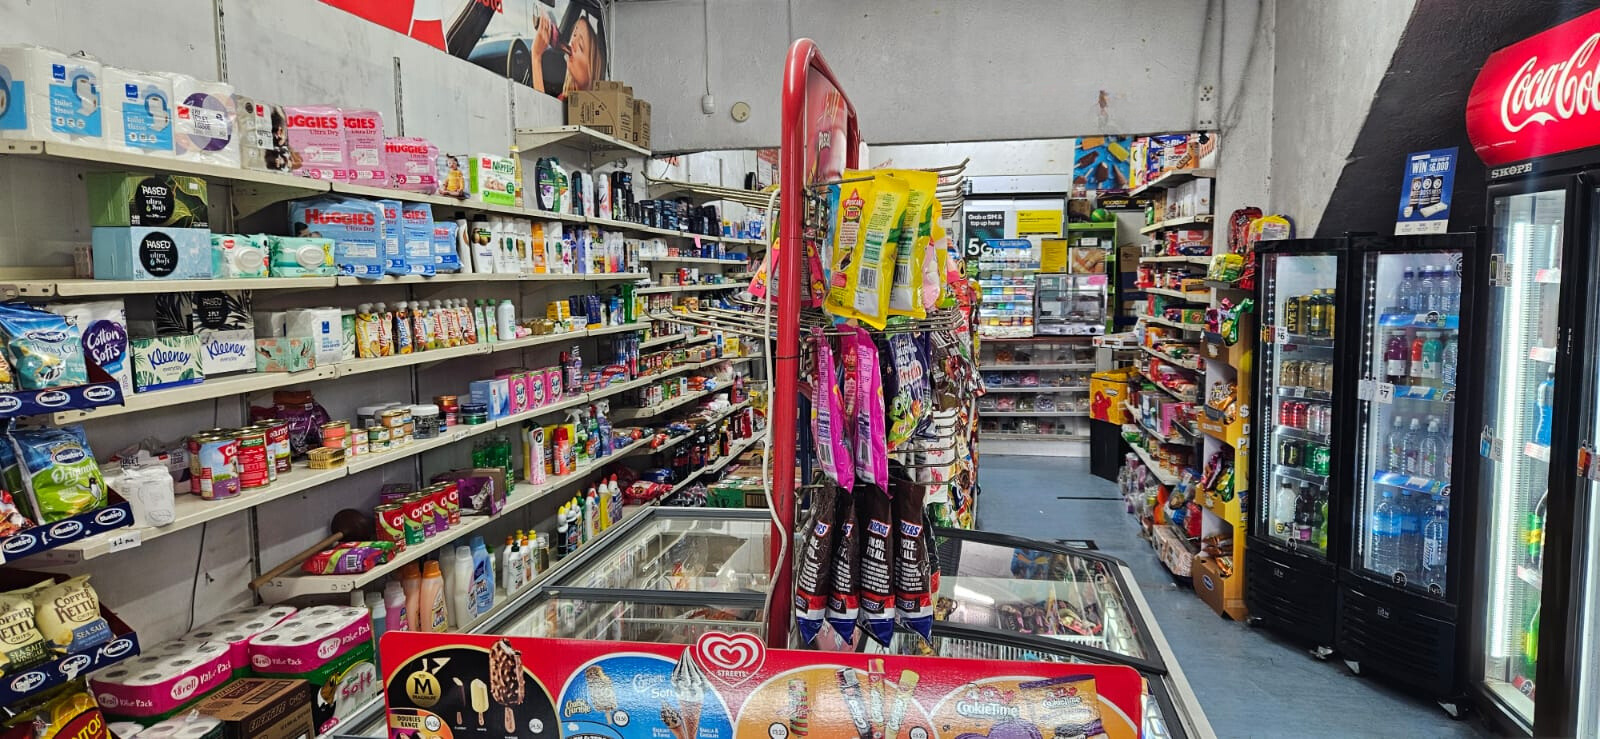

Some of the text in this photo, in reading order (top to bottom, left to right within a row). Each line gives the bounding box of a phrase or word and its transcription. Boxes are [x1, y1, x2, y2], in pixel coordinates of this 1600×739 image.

[287, 114, 338, 129] UGGIES
[343, 117, 376, 129] GIES
[385, 143, 429, 154] HUGGIES
[1412, 161, 1428, 174] WIN
[1491, 163, 1533, 179] SKOPE
[142, 184, 168, 196] PASEO
[304, 208, 376, 226] HUGGIES
[402, 209, 427, 220] GIES
[145, 239, 171, 249] PASEO
[87, 327, 120, 349] Cotton
[92, 343, 121, 366] Softs
[206, 340, 246, 360] Kleenex
[147, 348, 192, 370] Kleenex
[87, 389, 112, 397] Bluebird
[1380, 391, 1390, 399] $7
[56, 449, 85, 460] Bluebird
[99, 511, 122, 522] Bluebird
[54, 523, 78, 536] Bluebird
[5, 538, 32, 550] Bluebird
[54, 588, 91, 609] COPPER
[54, 598, 97, 624] KETTLE
[76, 622, 106, 640] SEA SALT
[358, 624, 370, 636] Pack
[107, 641, 129, 653] Bluebird
[200, 669, 217, 684] Value
[217, 660, 232, 674] Pack
[716, 670, 747, 678] STREETS
[341, 671, 373, 699] Soft
[414, 678, 433, 695] M
[652, 689, 674, 698] Soft
[136, 699, 153, 707] Pack
